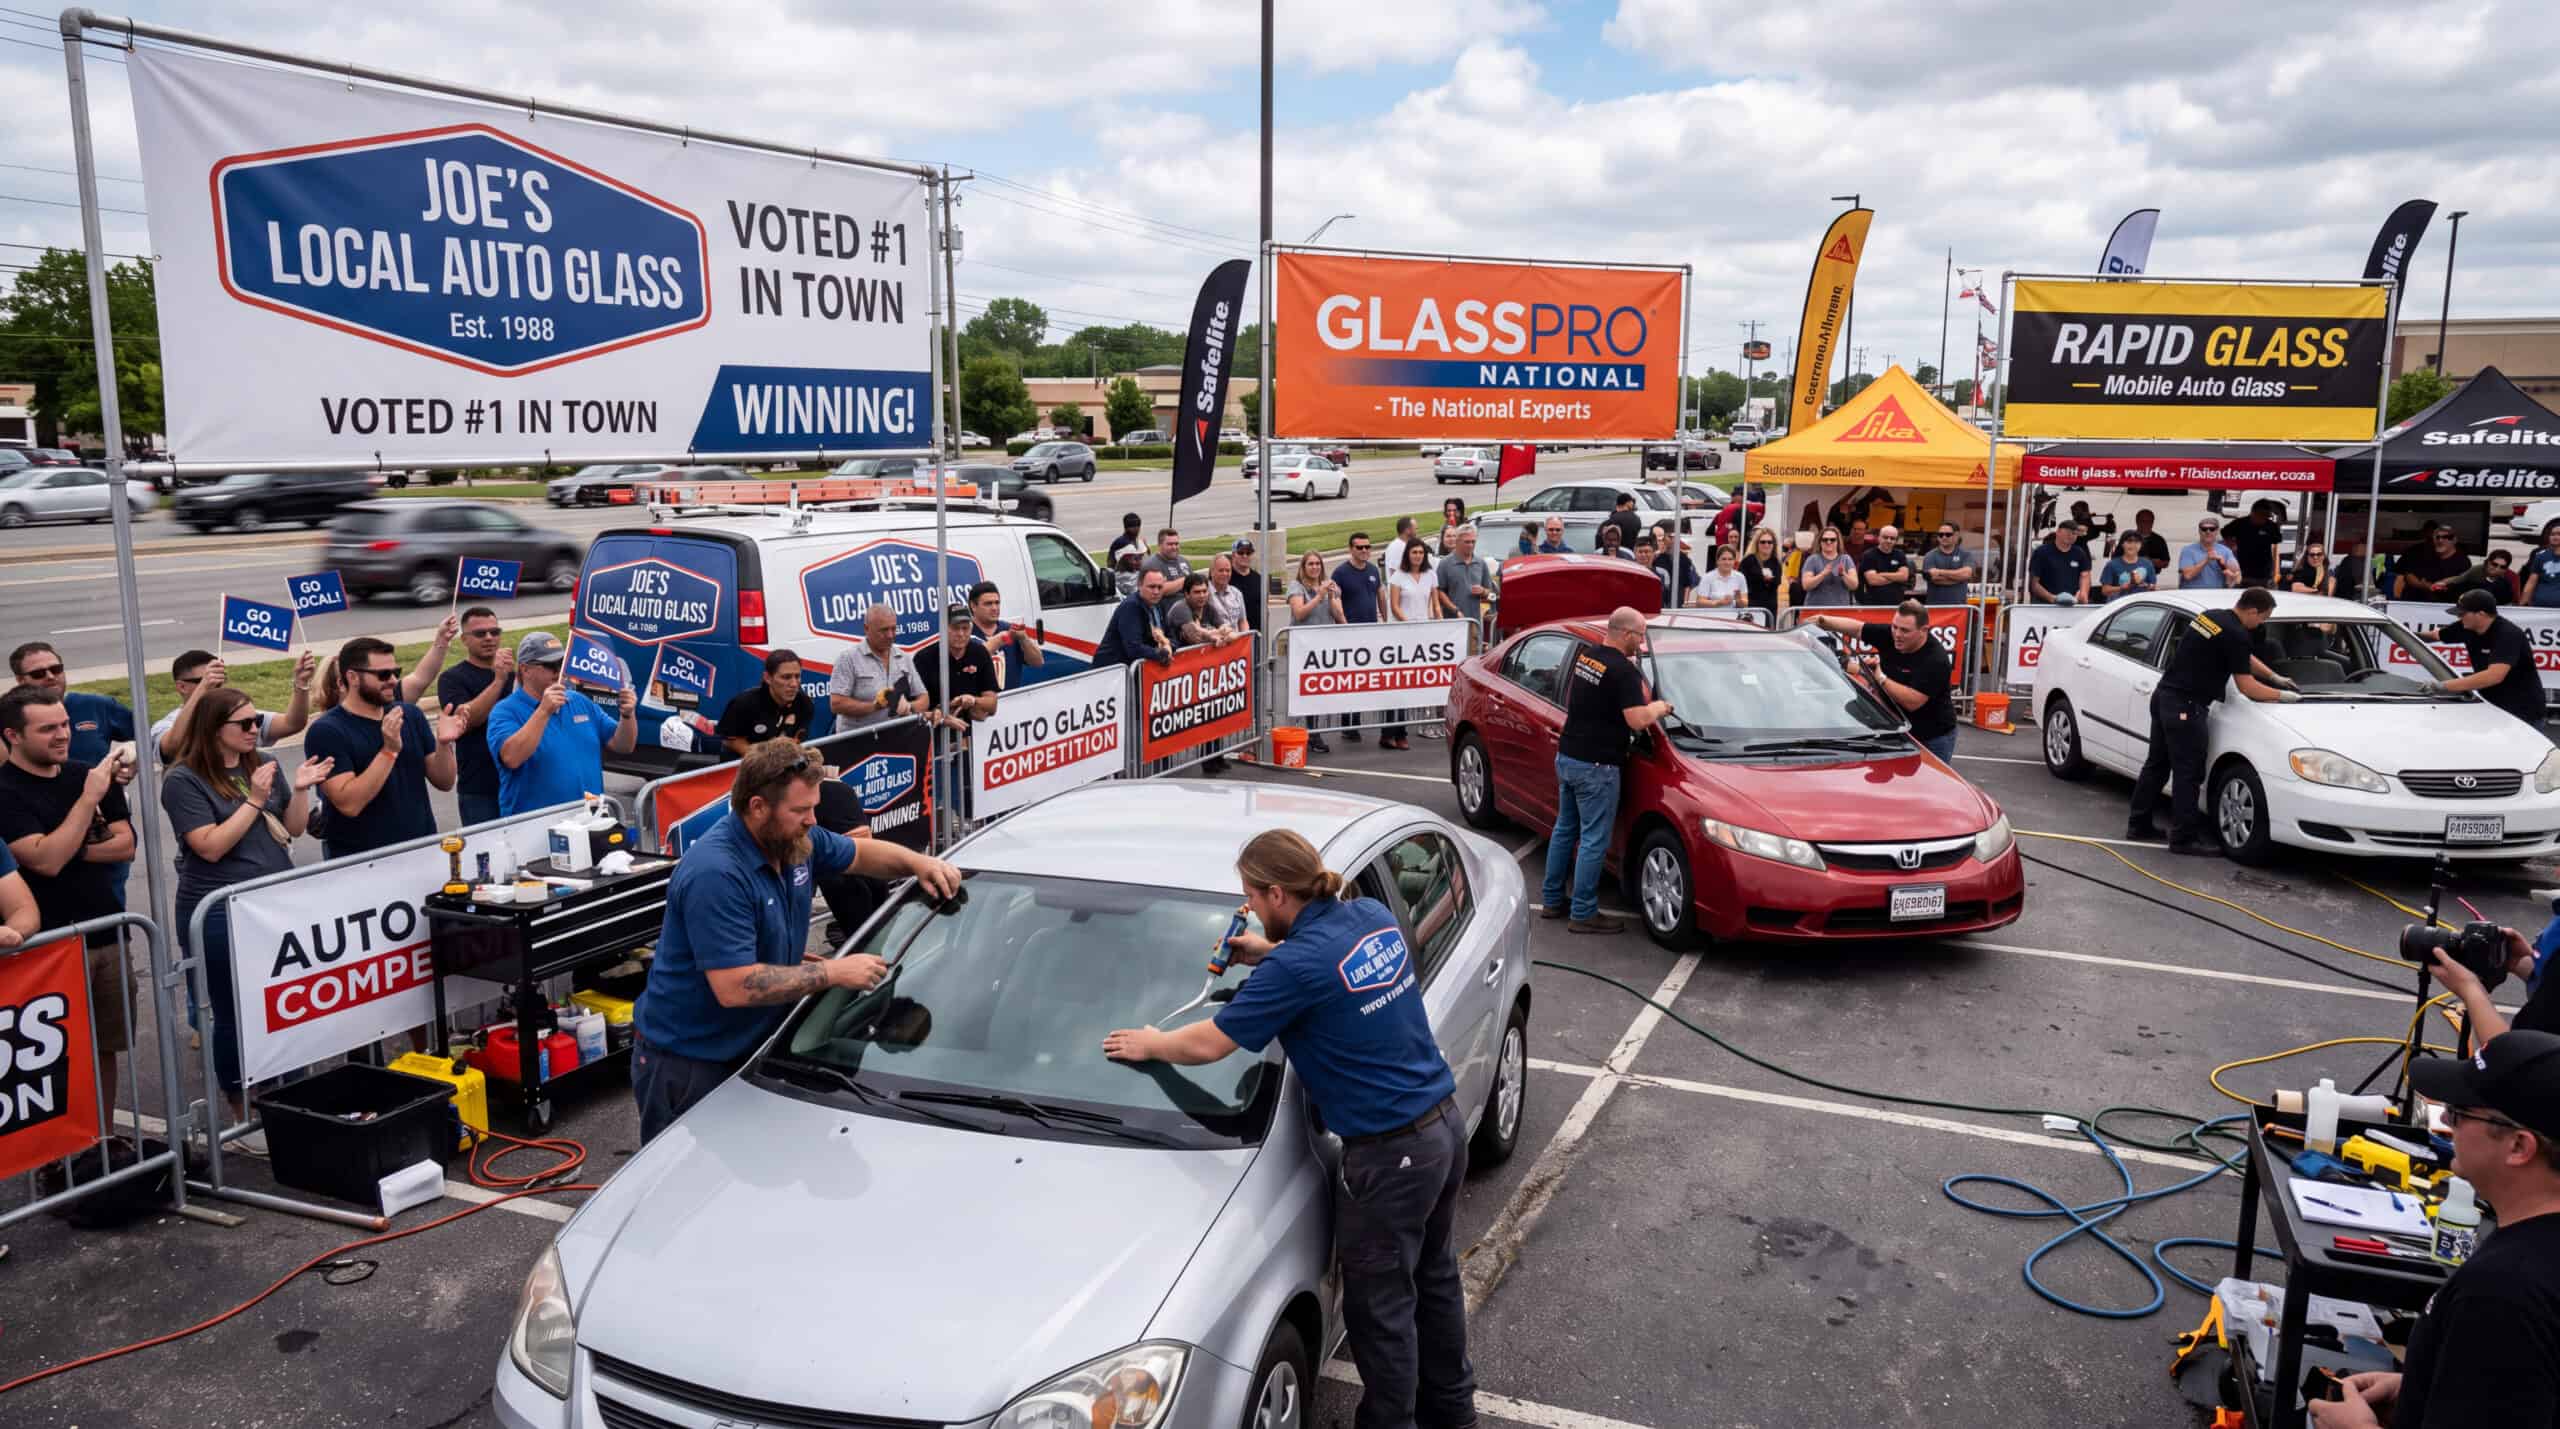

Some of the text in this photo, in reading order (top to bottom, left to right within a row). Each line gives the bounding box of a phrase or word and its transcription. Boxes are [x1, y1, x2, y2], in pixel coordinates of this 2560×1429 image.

[422, 158, 553, 233] JOE'S
[727, 200, 907, 266] VOTED #1
[267, 221, 683, 310] LOCAL AUTO GLASS
[740, 267, 904, 325] IN TOWN
[450, 313, 555, 342] Est. 1988
[1317, 295, 1647, 357] GLASSPRO
[2051, 323, 2194, 365] RAPID
[1197, 301, 1229, 414] Safelite
[1480, 365, 1640, 388] NATIONAL
[2104, 375, 2286, 398] Mobile Auto Glass
[321, 397, 657, 434] VOTED #1 IN TOWN
[732, 384, 915, 435] WINNING!
[1390, 397, 1425, 417] The
[1432, 398, 1514, 419] National
[1520, 399, 1591, 423] Experts
[300, 580, 321, 594] GO
[477, 565, 500, 578] GO
[628, 568, 671, 596] JOE'S
[869, 553, 923, 586] JOE'S
[246, 608, 271, 624] GO
[592, 593, 707, 624] LOCAL AUTO GLASS
[228, 619, 287, 643] LOCAL!
[588, 647, 608, 663] GO
[1303, 643, 1455, 670] AUTO GLASS
[1150, 659, 1247, 715] AUTO GLASS
[1304, 667, 1453, 693] COMPETITION
[987, 697, 1116, 757] AUTO GLASS
[1152, 690, 1245, 738] COMPETITION
[989, 727, 1116, 784] COMPETITION
[270, 900, 416, 978] AUTO
[276, 945, 434, 1021] COMPE
